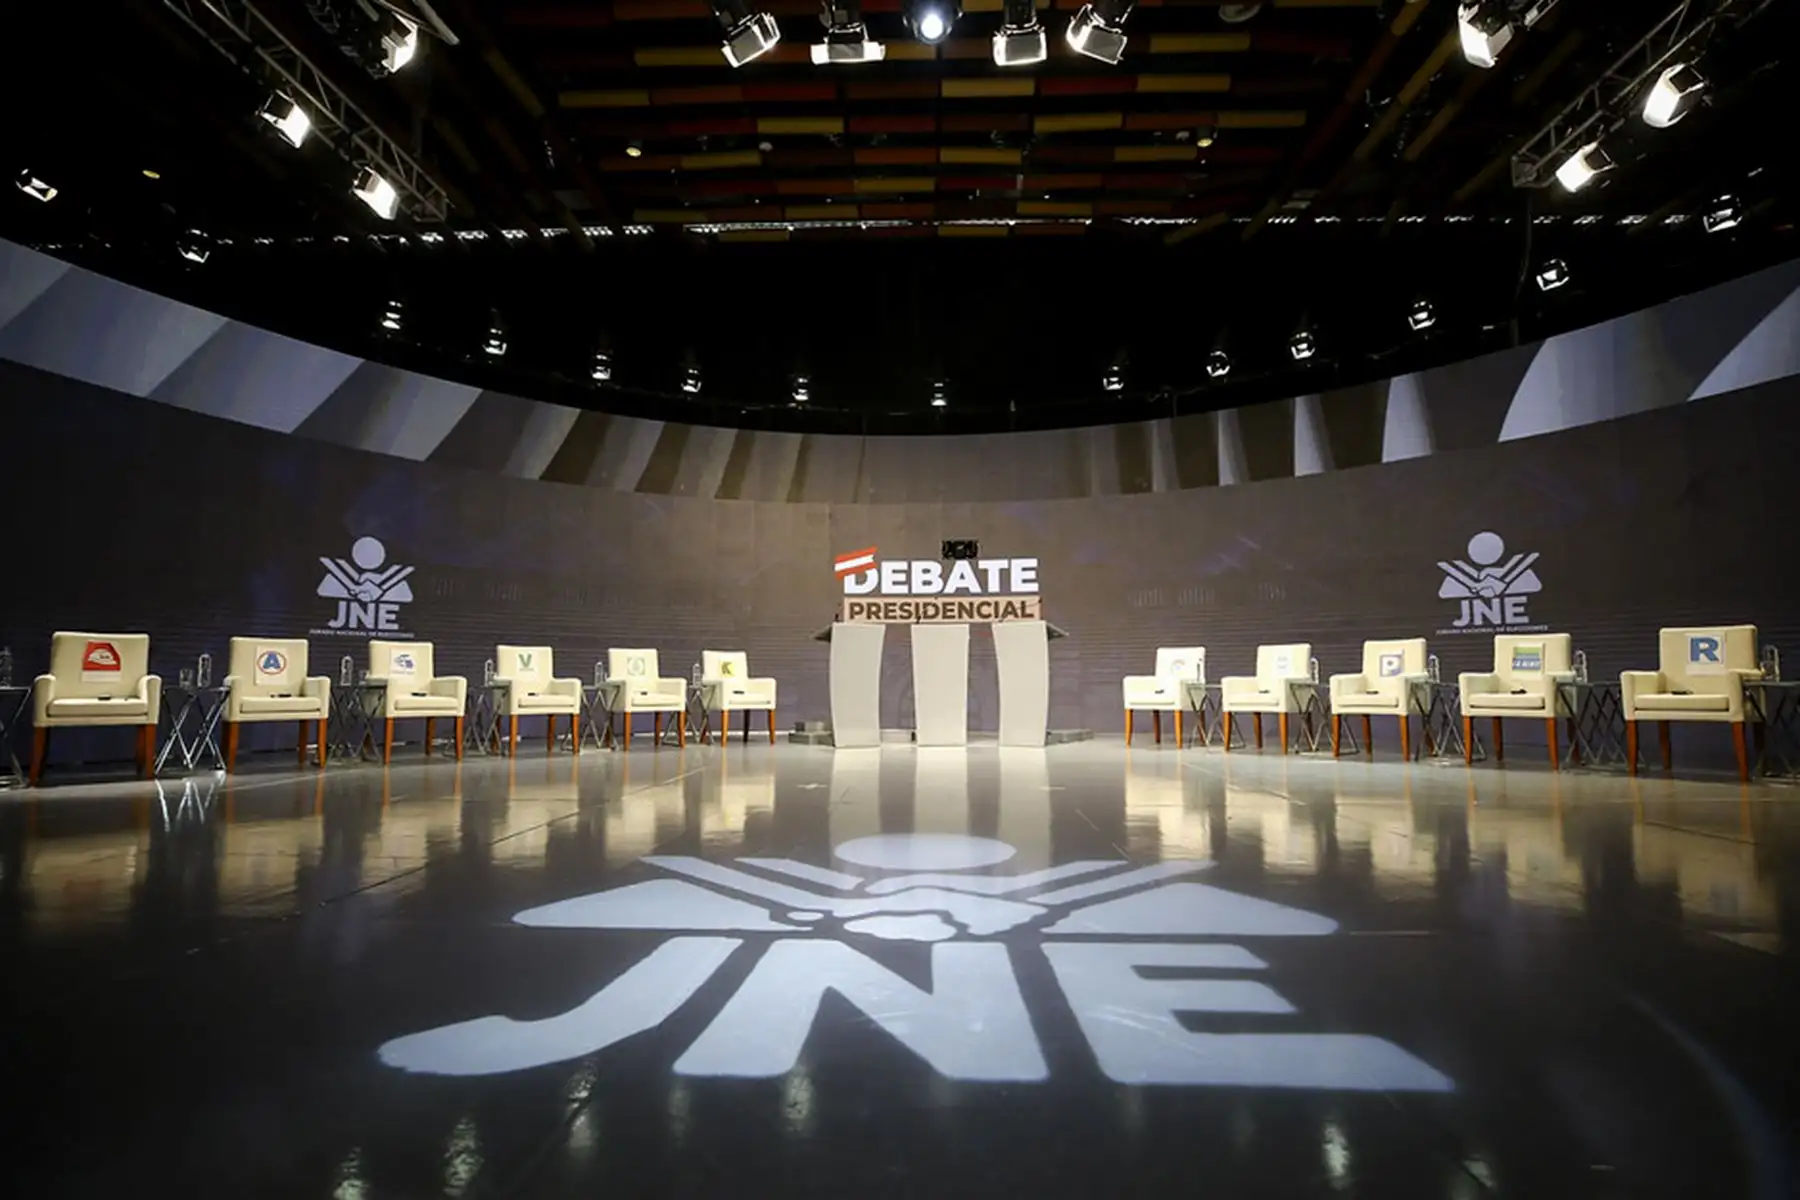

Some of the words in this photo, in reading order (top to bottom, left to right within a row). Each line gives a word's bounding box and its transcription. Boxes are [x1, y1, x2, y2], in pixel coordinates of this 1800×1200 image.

[844, 558, 1039, 594] DEBATE
[328, 600, 399, 630] JNE
[850, 600, 1034, 620] PRESIDENCIAL
[1452, 596, 1529, 627] JNE
[263, 651, 281, 669] A
[518, 653, 532, 668] V
[1690, 637, 1720, 662] R
[1382, 656, 1401, 677] P
[375, 936, 1455, 1091] JNE
